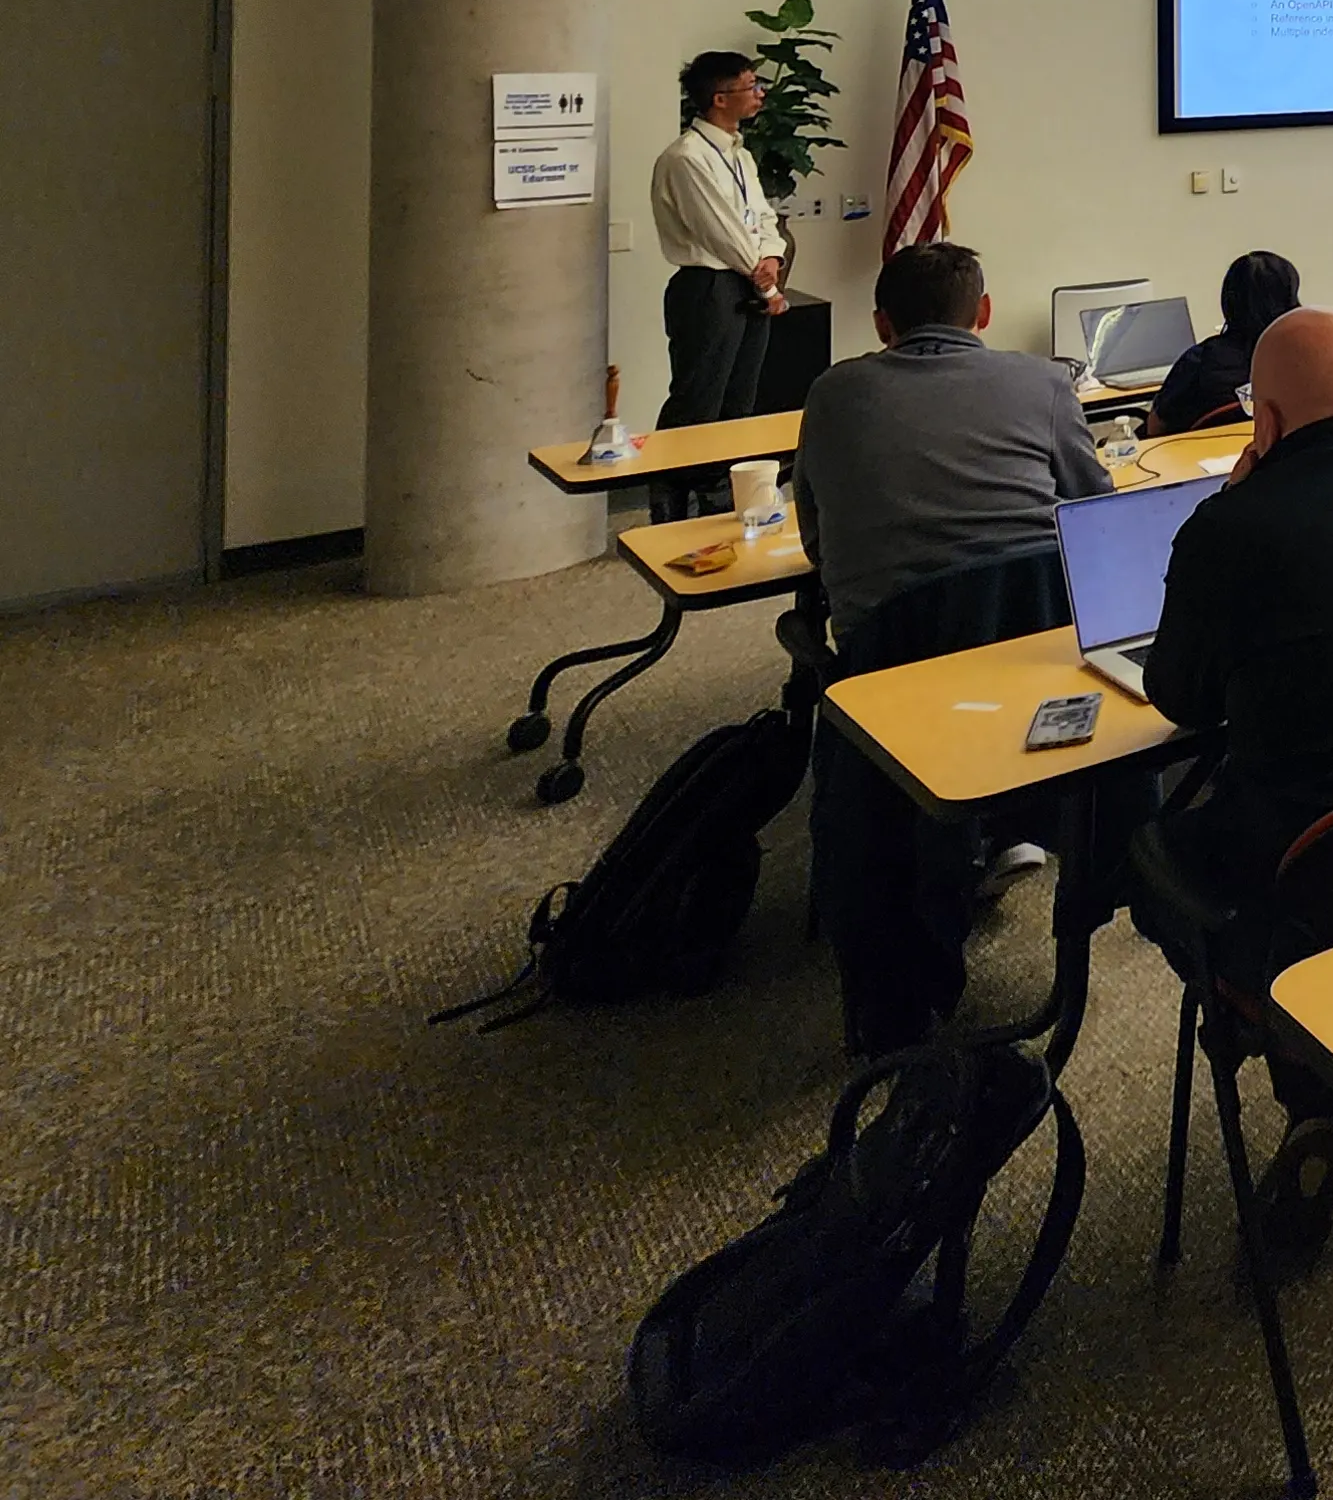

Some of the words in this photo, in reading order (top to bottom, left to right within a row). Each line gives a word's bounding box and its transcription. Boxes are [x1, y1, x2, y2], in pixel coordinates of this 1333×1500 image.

[1271, 0, 1285, 9] An
[1288, 0, 1333, 11] OpenAPI
[1271, 14, 1323, 24] Reference
[1271, 28, 1310, 38] Multiple
